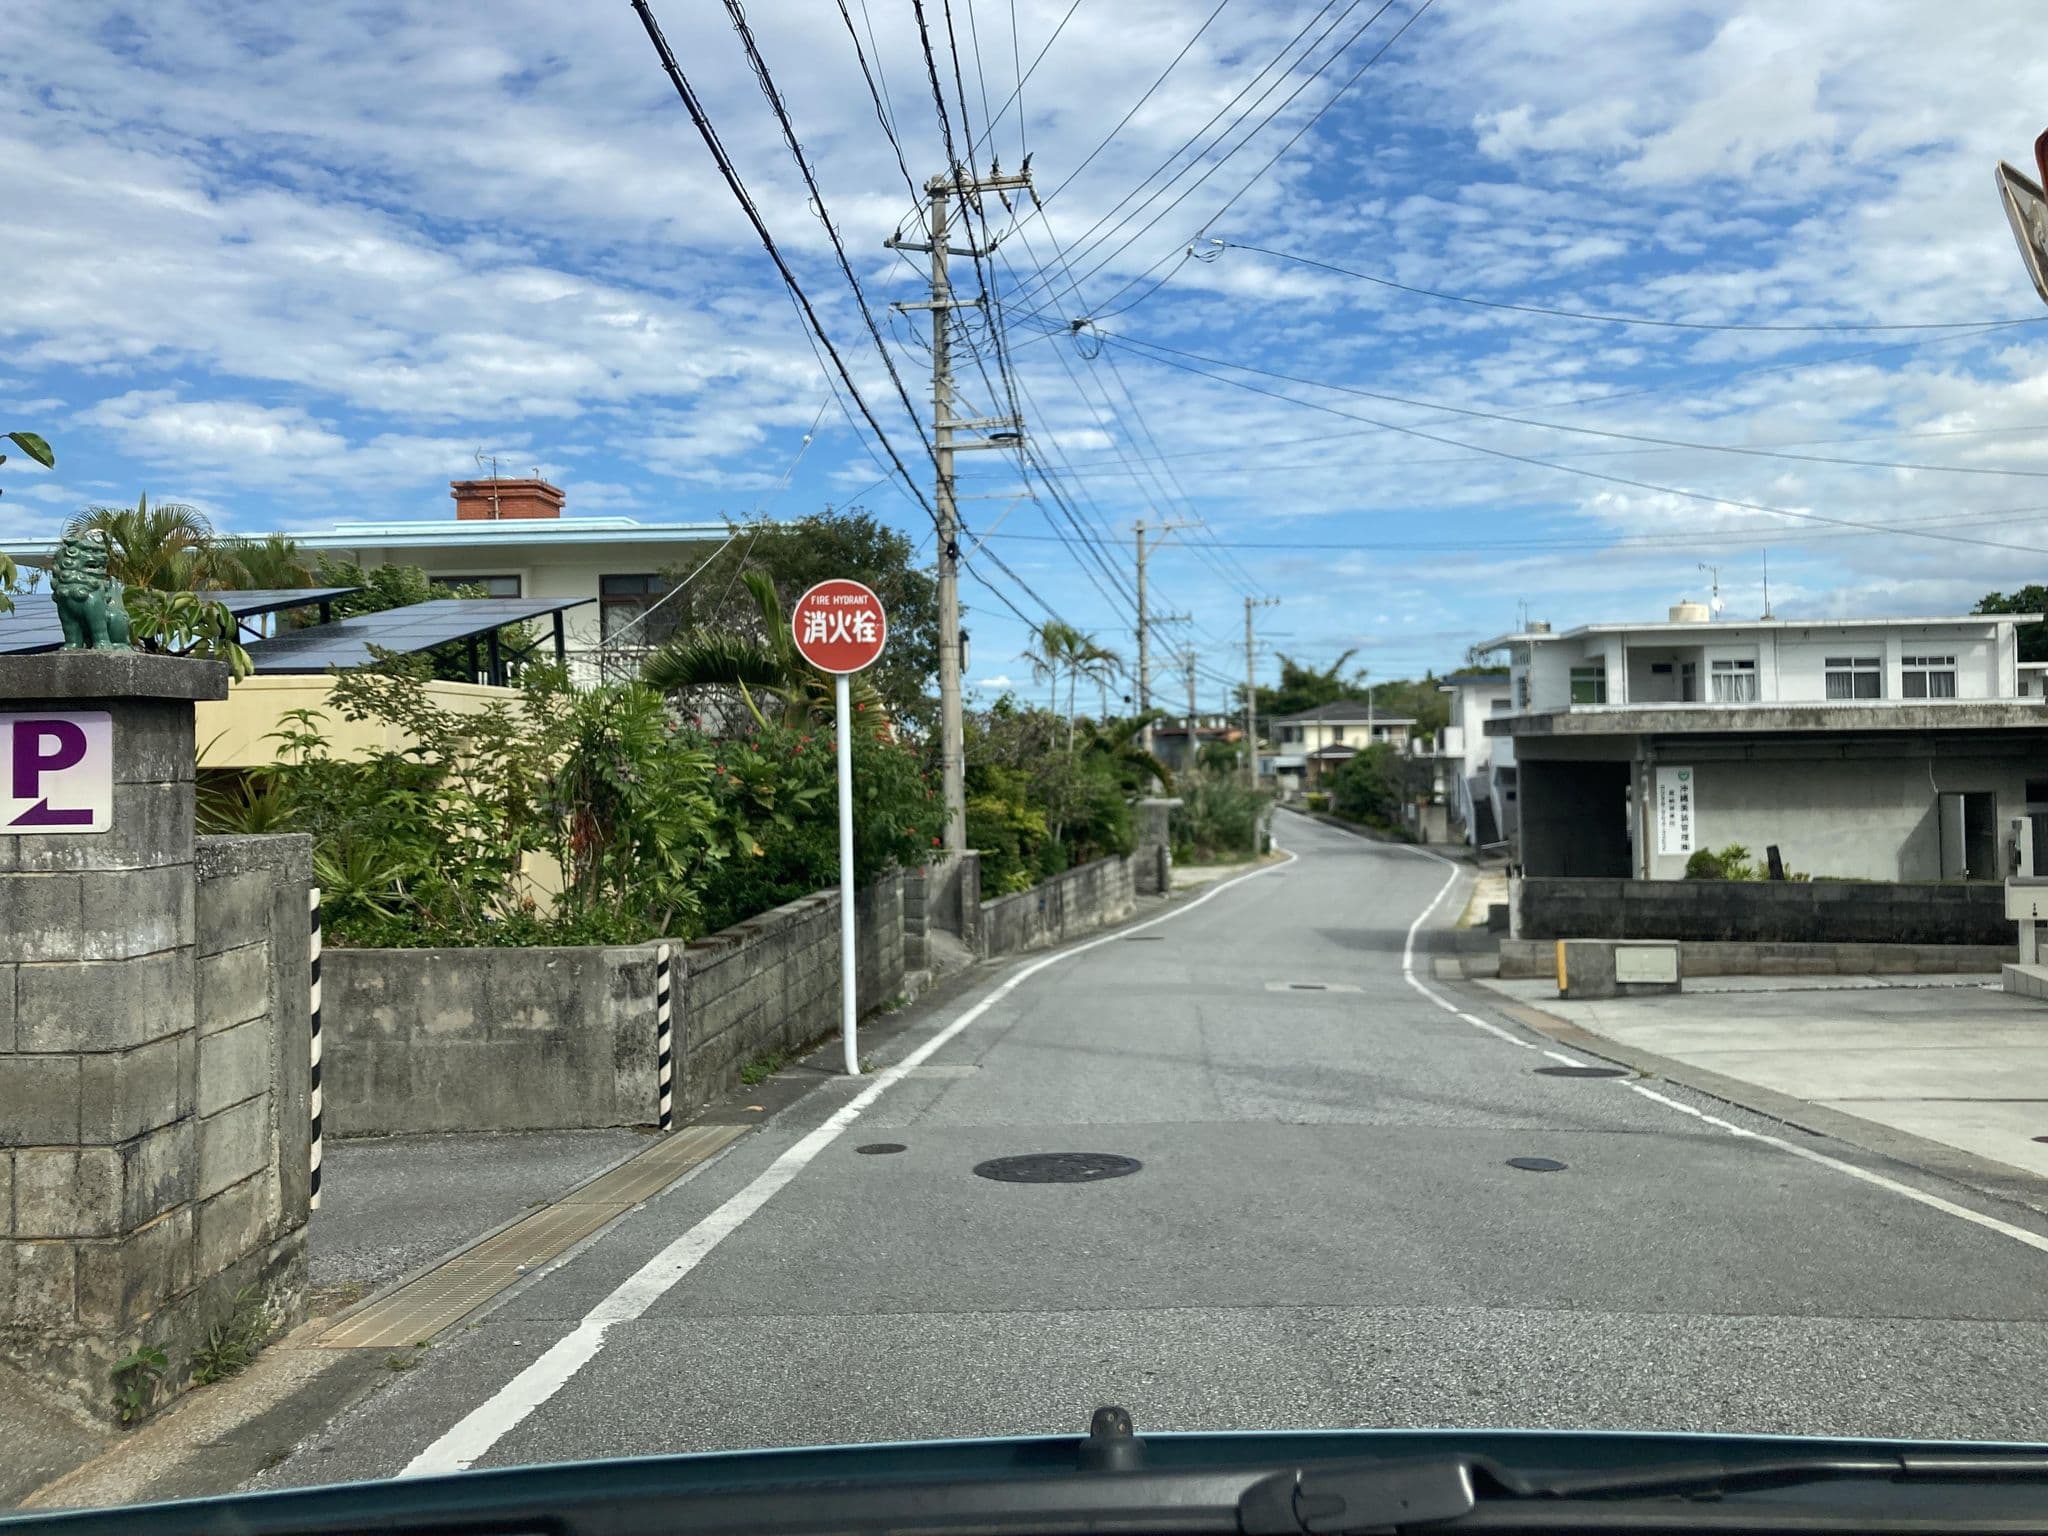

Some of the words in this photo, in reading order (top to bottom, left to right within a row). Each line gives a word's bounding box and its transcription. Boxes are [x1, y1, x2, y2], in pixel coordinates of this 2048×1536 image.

[810, 595, 831, 606] FIRE
[832, 594, 869, 606] HYDRANT
[803, 609, 877, 644] 消火栓
[12, 719, 87, 799] P
